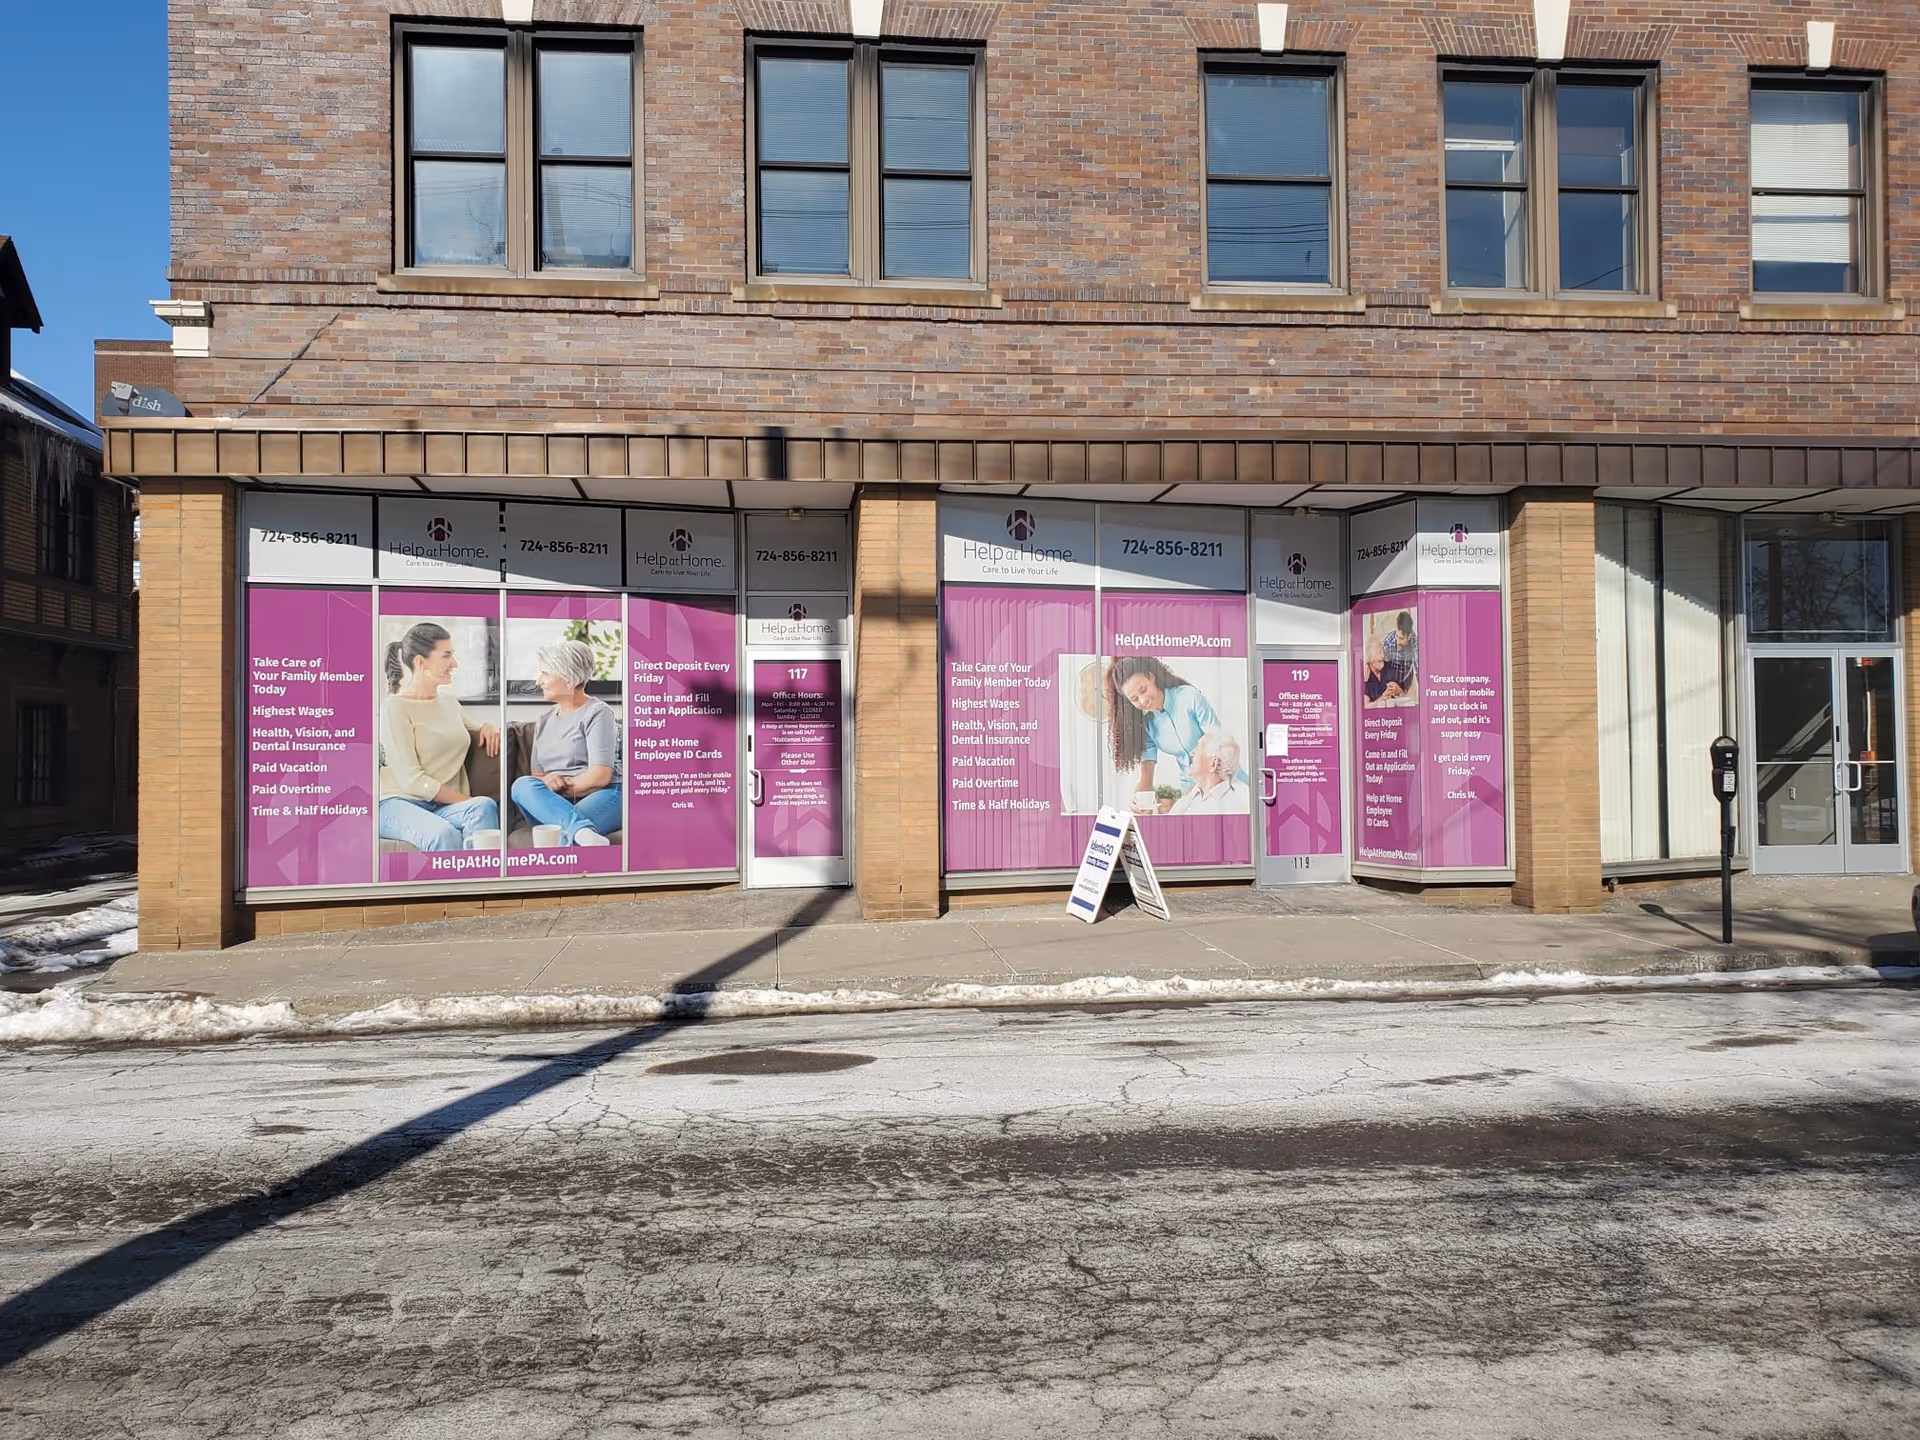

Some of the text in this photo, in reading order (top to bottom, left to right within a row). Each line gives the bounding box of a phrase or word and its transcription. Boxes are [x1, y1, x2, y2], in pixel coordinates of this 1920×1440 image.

[132, 397, 161, 411] dish
[261, 531, 358, 545] 724-856-8211
[390, 542, 424, 559] Help
[426, 549, 437, 557] at
[520, 540, 608, 554] 724-856-8211
[964, 541, 1003, 564] Help
[1006, 550, 1019, 560] at
[1122, 540, 1223, 557] 724-856-8211
[1357, 540, 1408, 560] 724-856-8211
[1422, 544, 1448, 558] Help
[636, 552, 667, 568] Help
[756, 551, 837, 561] 724-856-8211
[1011, 566, 1025, 574] Live
[1027, 567, 1043, 575] Your
[1260, 576, 1285, 592] Help
[1287, 581, 1295, 589] at
[761, 623, 787, 635] Help
[1116, 633, 1231, 649] HelpAtHomePA.com
[253, 657, 322, 667] Take Care of
[634, 661, 730, 672] Direct Deposit Every
[951, 662, 1031, 673] Take Care of Your
[253, 671, 364, 683] Your Family Member
[634, 673, 664, 684] Friday
[788, 668, 807, 679] 117
[1291, 670, 1309, 681] 119
[952, 676, 1051, 689] Family Member Today
[1456, 676, 1490, 684] company.
[253, 684, 286, 696] Today
[1450, 688, 1468, 696] their
[1470, 688, 1495, 696] mobile
[634, 693, 710, 702] Come in and Fill
[1279, 692, 1299, 700] Office
[952, 698, 1020, 710] Highest Wages
[1433, 704, 1448, 712] app
[1459, 702, 1479, 710] clock
[1480, 702, 1487, 710] in
[253, 706, 334, 718] Highest Wages
[634, 706, 651, 714] Out
[668, 705, 722, 716] Application
[634, 718, 665, 729] Today!
[1365, 717, 1402, 728] Direct Deposit
[1431, 716, 1446, 724] and
[1463, 716, 1477, 724] and
[1479, 715, 1490, 724] it's
[952, 720, 1038, 731] Health, Vision, and
[253, 728, 355, 738] Health, Vision, and
[1365, 730, 1397, 741] Every Friday
[1441, 731, 1481, 739] super easy
[634, 738, 656, 749] Help
[671, 738, 699, 746] Home
[952, 735, 1030, 744] Dental Insurance
[253, 741, 346, 751] Dental Insurance
[635, 750, 722, 761] Employee ID Cards
[1365, 749, 1408, 758] Come in and Fill
[1438, 754, 1451, 763] get
[1452, 753, 1468, 763] paid
[1470, 754, 1491, 763] every
[952, 756, 1015, 766] Paid Vacation
[253, 763, 327, 772] Paid Vacation
[1366, 762, 1375, 770] Out
[1384, 762, 1415, 772] Application
[952, 777, 1018, 788] Paid Overtime
[252, 784, 331, 794] Paid Overtime
[1366, 794, 1378, 804] Help
[1386, 794, 1402, 803] Home
[1448, 791, 1477, 799] Chris W.
[952, 798, 1050, 811] Time & Half Holidays
[252, 805, 368, 816] Time & Half Holidays
[1367, 806, 1392, 816] Employee
[1367, 818, 1389, 827] ID Cards
[1360, 847, 1417, 860] HelpAtHomePA.com
[432, 853, 577, 871] HelpAtHomePA.com
[1294, 857, 1310, 869] 119
